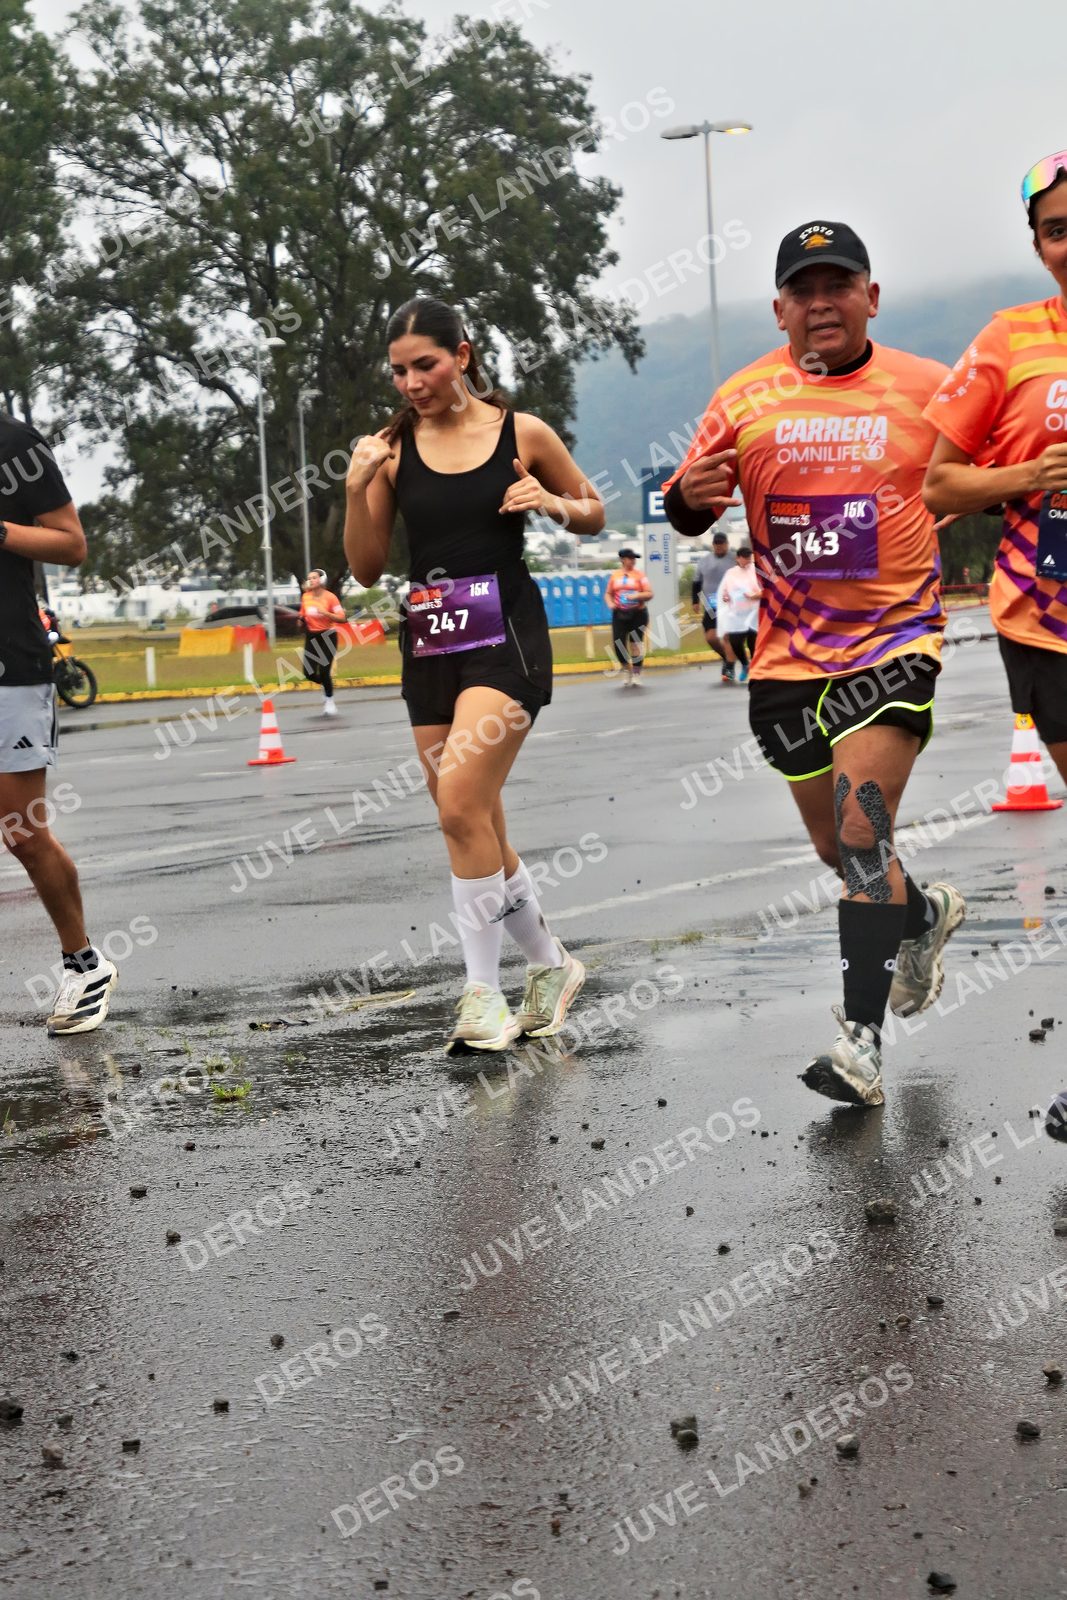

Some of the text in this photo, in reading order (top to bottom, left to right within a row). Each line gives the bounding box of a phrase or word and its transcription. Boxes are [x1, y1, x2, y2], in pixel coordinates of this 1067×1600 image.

[799, 226, 834, 240] KYOTO
[775, 416, 888, 445] CARRERA
[777, 445, 861, 464] OMNILIFE
[791, 532, 839, 555] 143
[427, 609, 469, 634] 247
